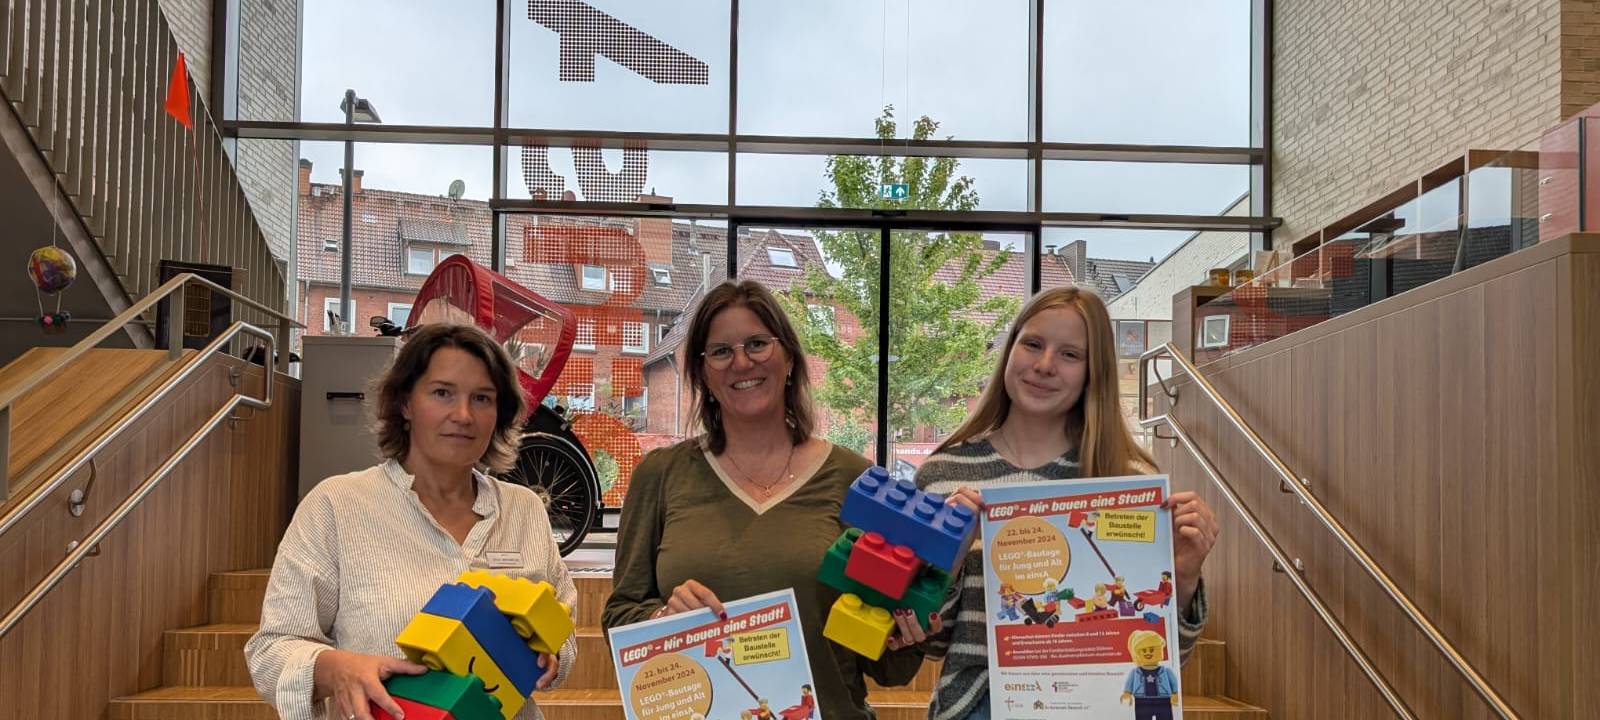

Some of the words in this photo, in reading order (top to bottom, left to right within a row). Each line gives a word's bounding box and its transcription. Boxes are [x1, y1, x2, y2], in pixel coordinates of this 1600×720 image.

[1029, 501, 1049, 514] Wir
[1051, 500, 1088, 512] bauen
[1090, 495, 1116, 507] eine
[1118, 491, 1156, 505] Stadt!
[1104, 512, 1135, 521] Betreten
[1108, 521, 1142, 530] Baustelle
[1007, 529, 1019, 537] 22.
[1019, 527, 1031, 535] bis
[1031, 526, 1043, 534] 24.
[1106, 531, 1146, 539] erwünscht!
[997, 537, 1036, 547] November
[1037, 535, 1056, 544] 2024
[1000, 562, 1011, 571] für
[1012, 562, 1032, 571] Jung
[1033, 559, 1049, 568] und
[1015, 573, 1025, 581] im
[664, 638, 684, 652] Wir
[686, 627, 720, 645] bauen
[723, 619, 747, 634] eine
[749, 607, 784, 627] Stadt!
[739, 633, 768, 643] Betreten
[769, 632, 780, 640] der
[744, 642, 776, 652] Baustelle
[743, 650, 781, 661] erwünscht!
[644, 670, 657, 679] 22.
[657, 666, 669, 675] bis
[670, 662, 682, 671] 24.
[636, 675, 675, 691] November
[676, 668, 695, 680] 2024
[641, 706, 654, 717] für
[655, 701, 676, 714] Jung
[676, 695, 693, 706] und
[693, 691, 706, 701] Alt
[671, 706, 694, 719] einsA
